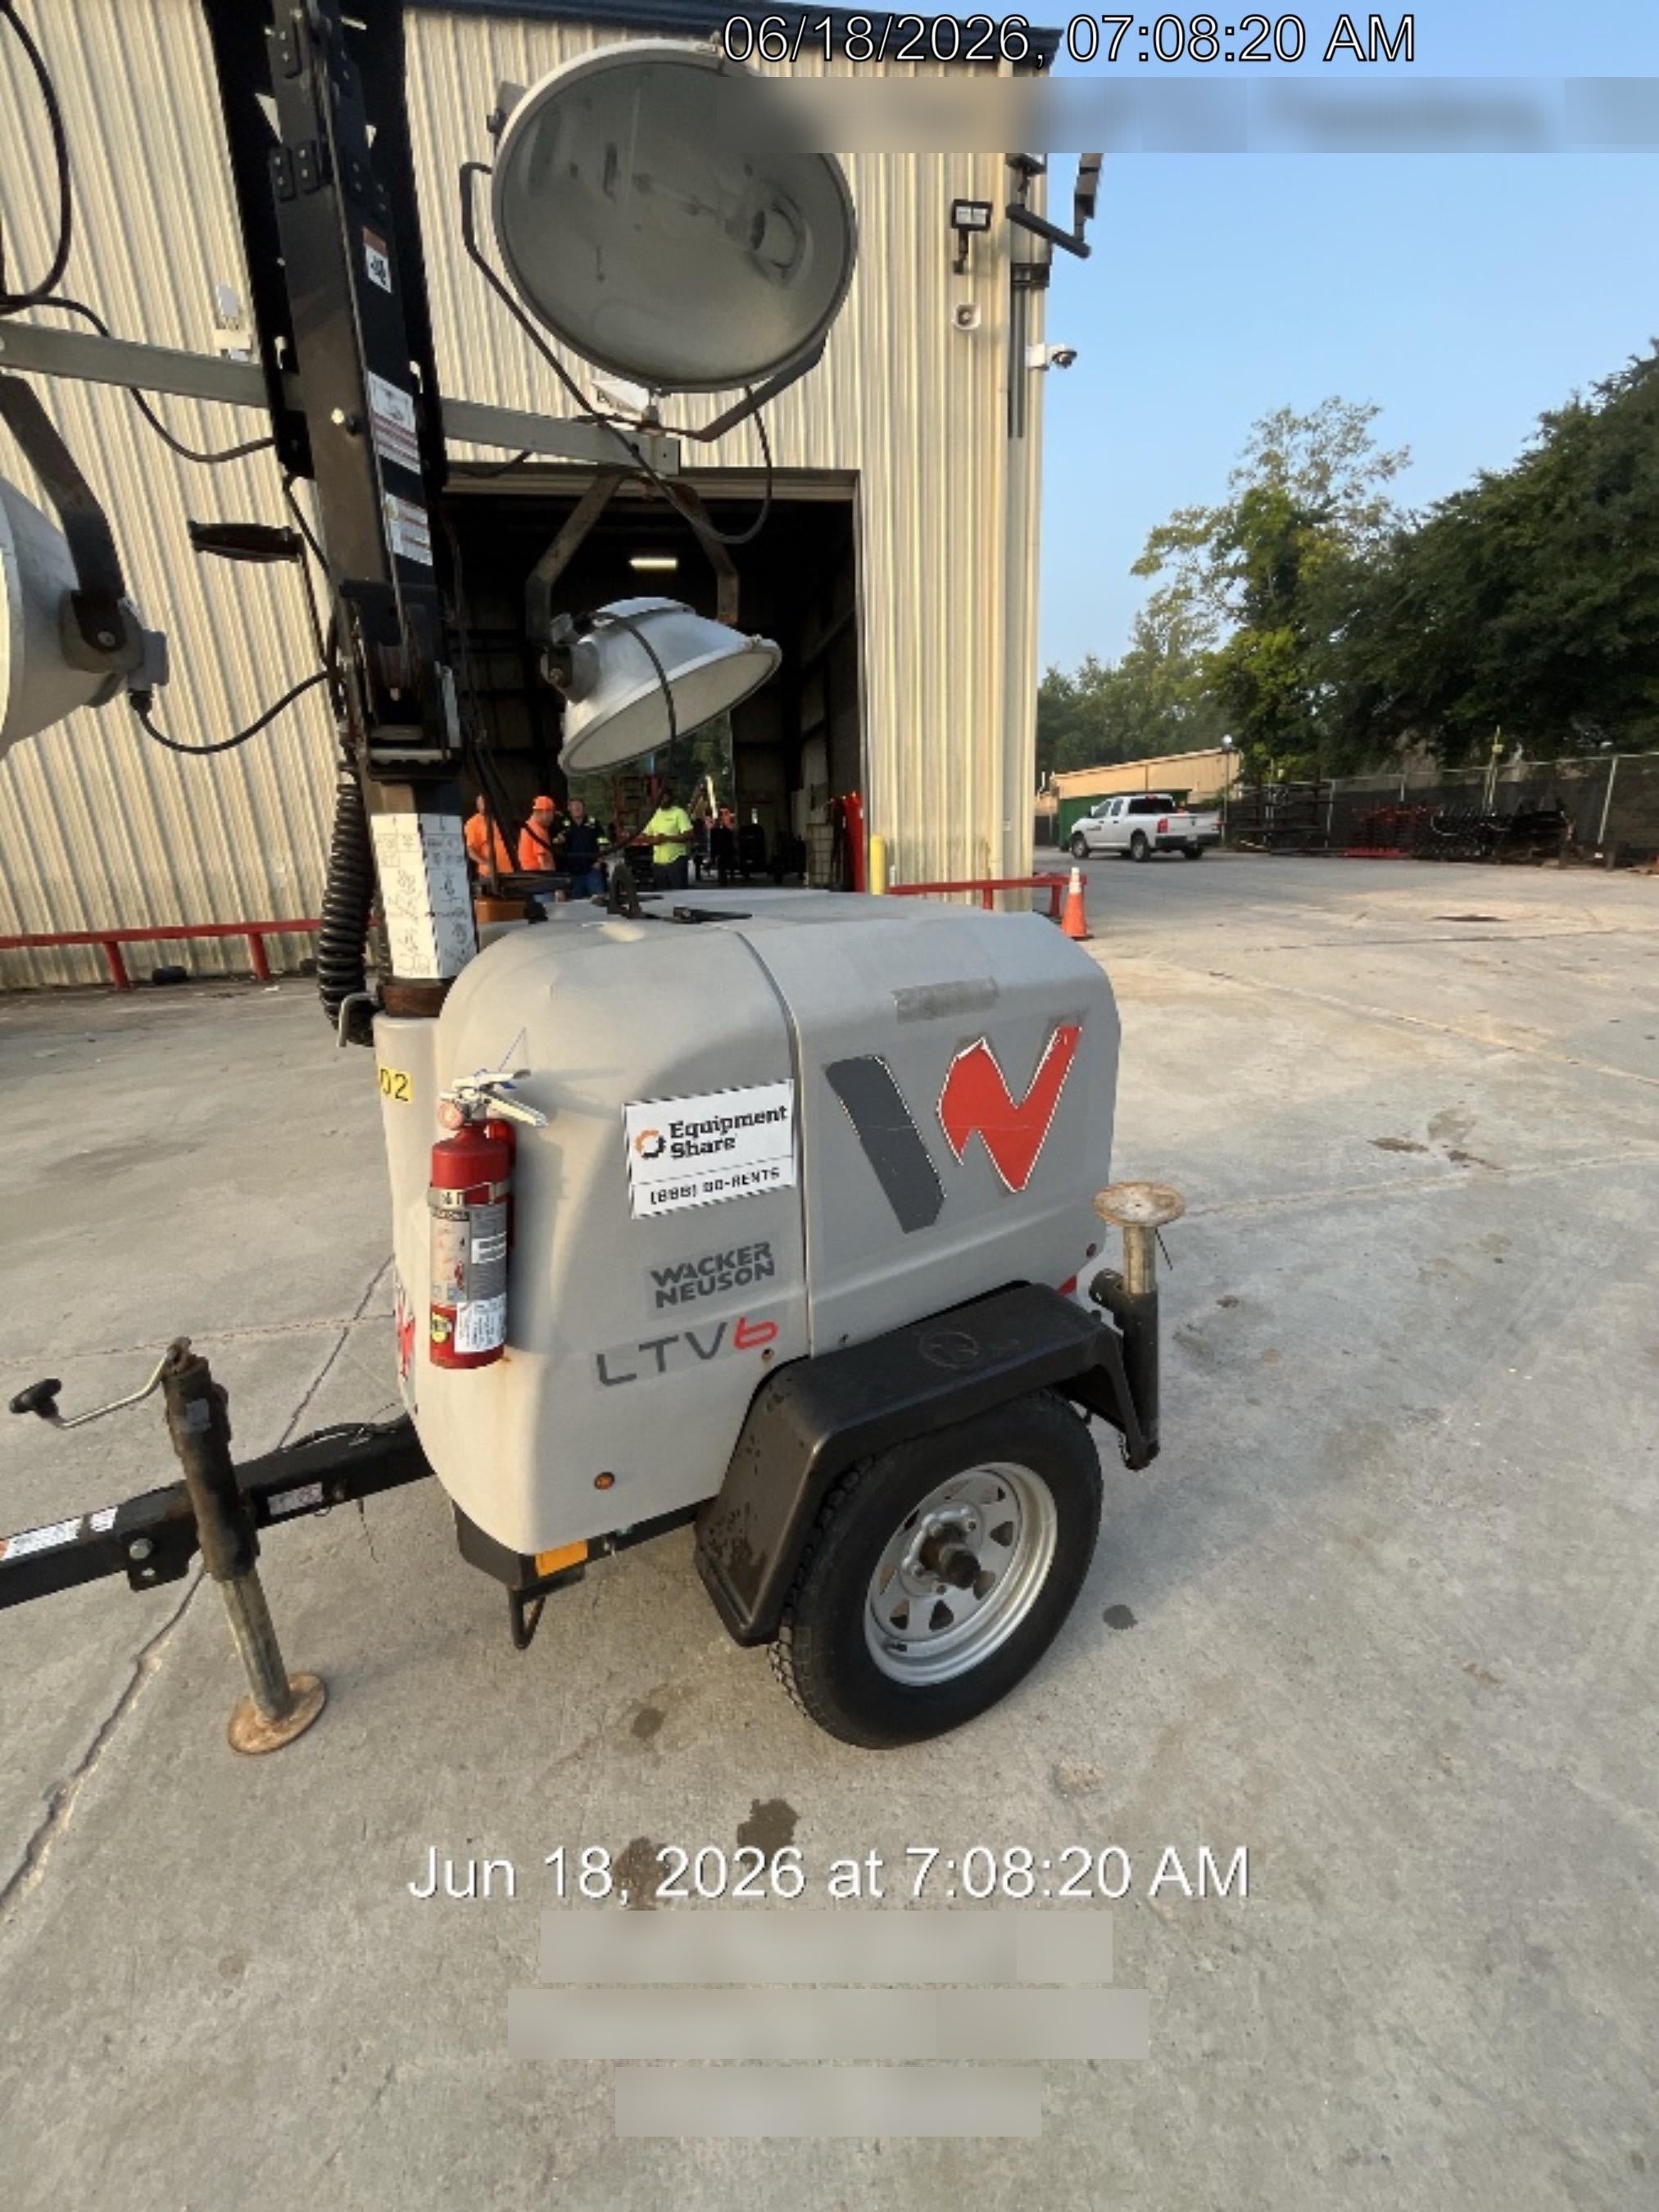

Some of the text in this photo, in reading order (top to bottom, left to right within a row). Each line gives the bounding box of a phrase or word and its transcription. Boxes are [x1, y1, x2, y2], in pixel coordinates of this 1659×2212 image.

[669, 1106, 787, 1139] Equipment
[670, 1137, 736, 1159] Share
[650, 1241, 773, 1287] WACKER
[655, 1258, 775, 1308] NEUSON
[596, 1316, 778, 1386] LTV6
